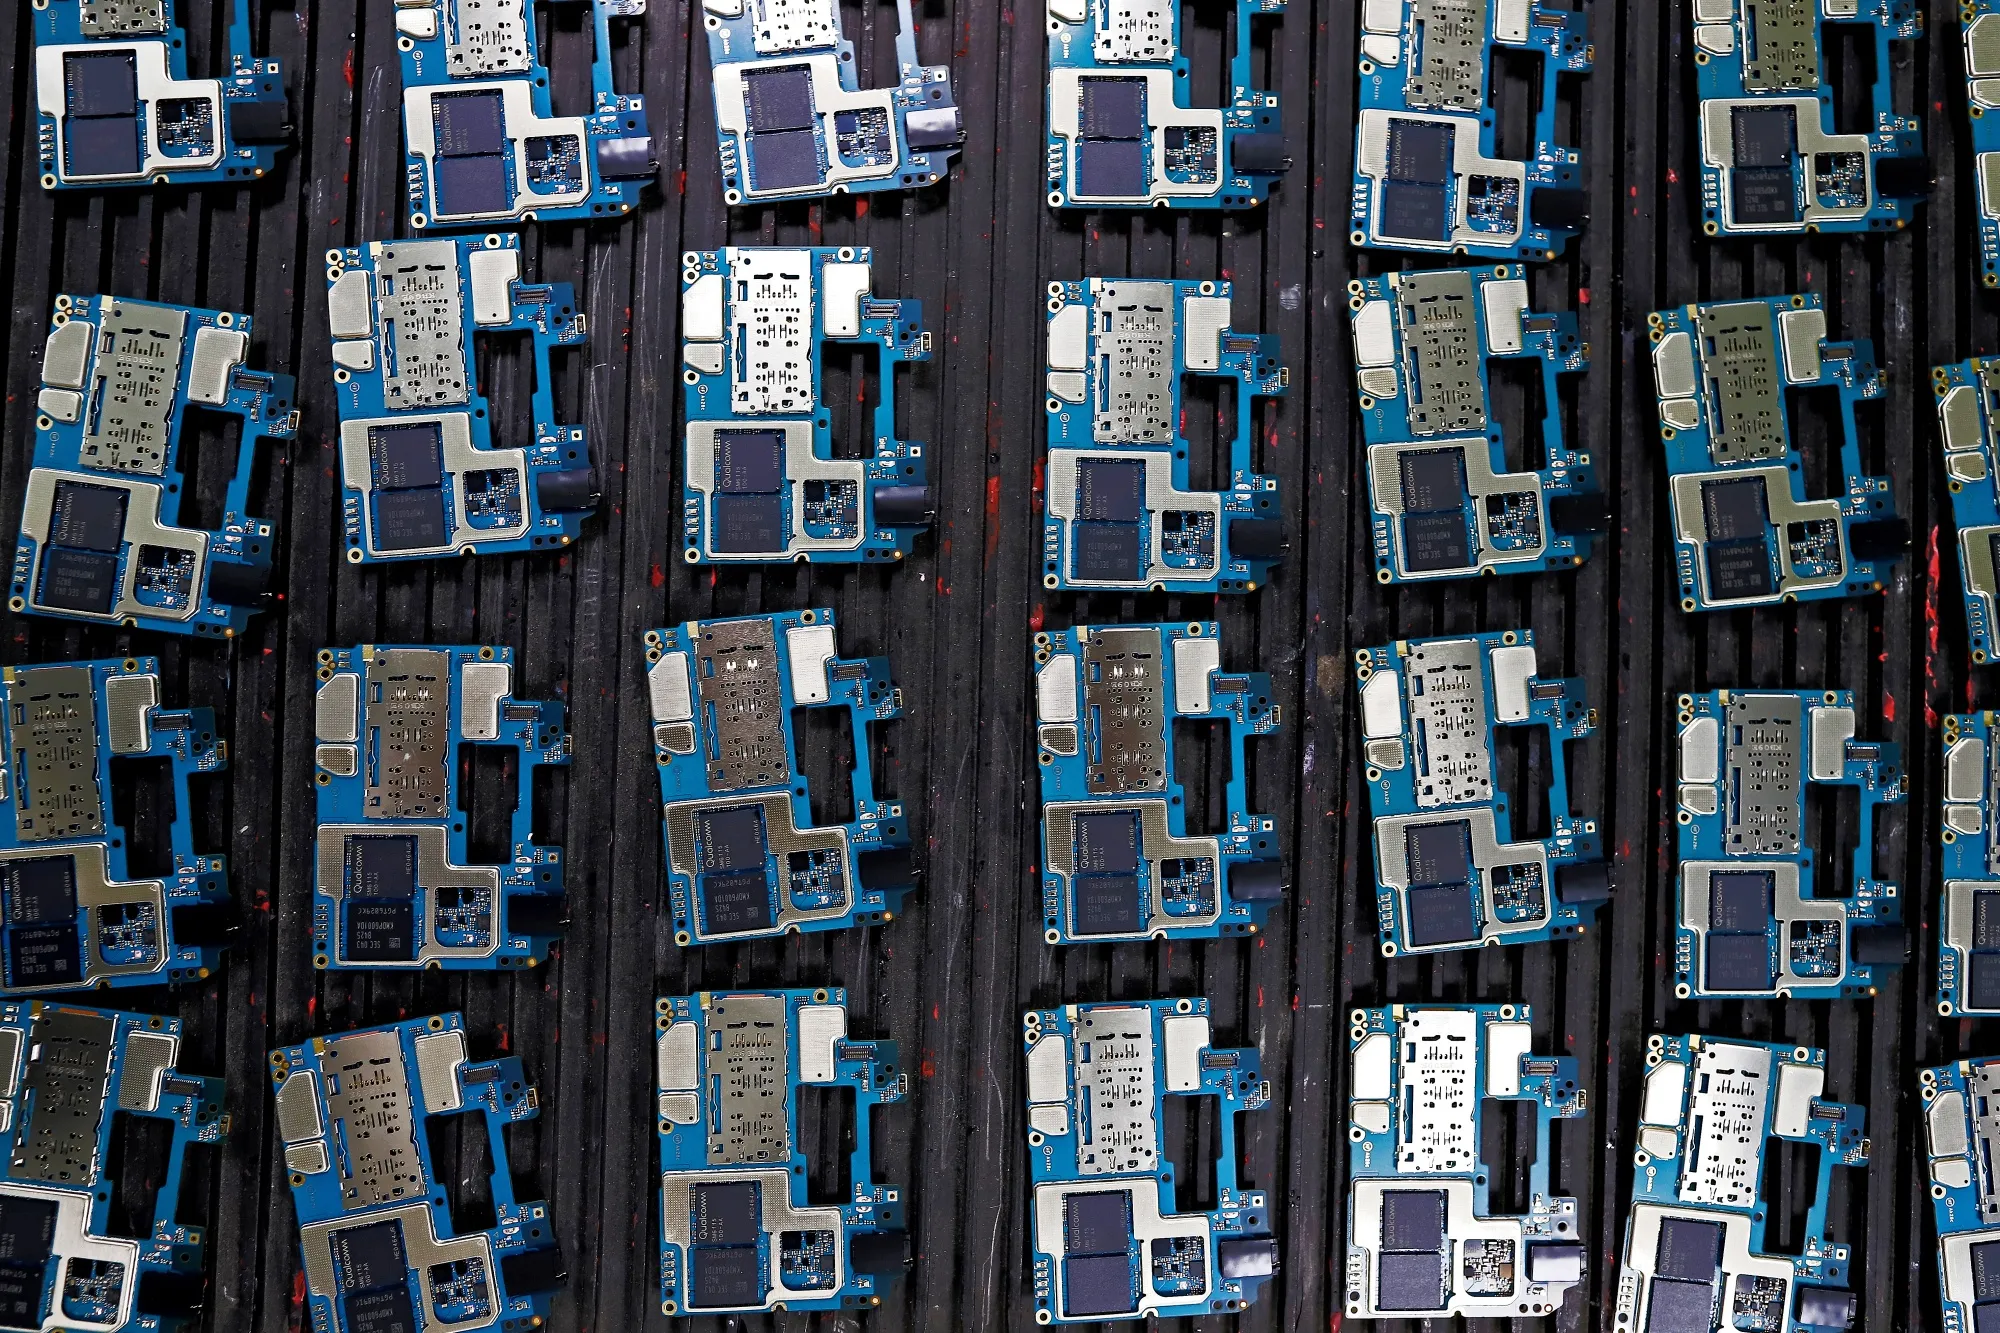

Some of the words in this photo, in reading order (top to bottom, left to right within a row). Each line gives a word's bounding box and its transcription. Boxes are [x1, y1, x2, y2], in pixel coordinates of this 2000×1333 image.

[74, 63, 86, 112] Qualcomm
[752, 79, 764, 127] Qualcomm
[1085, 86, 1095, 133] Qualcomm
[442, 102, 453, 150] Qualcomm
[1737, 116, 1748, 162] Qualcomm
[1392, 129, 1402, 175] Qualcomm
[379, 435, 391, 485] Qualcomm
[722, 439, 732, 488] Qualcomm
[1406, 460, 1418, 508] Qualcomm
[58, 491, 74, 540] Qualcomm
[1083, 468, 1093, 516] Qualcomm
[1708, 490, 1721, 537] Qualcomm
[704, 818, 715, 868] Qualcomm
[1079, 820, 1090, 869] Qualcomm
[1412, 833, 1423, 881] Qualcomm
[353, 844, 363, 894] Qualcomm
[11, 869, 23, 919] Qualcomm
[714, 903, 730, 913] B425
[715, 913, 727, 922] 043
[728, 911, 739, 920] SEC
[1713, 880, 1724, 926] Qualcomm
[356, 931, 371, 939] B425
[356, 940, 367, 948] 043
[370, 940, 380, 948] SEC
[1977, 898, 1987, 945] Qualcomm
[698, 1191, 708, 1240] Qualcomm
[1071, 1200, 1081, 1249] Qualcomm
[1386, 1198, 1396, 1245] Qualcomm
[341, 1238, 355, 1288] Qualcomm
[1661, 1225, 1673, 1272] Qualcomm
[1976, 1250, 1988, 1296] Qualcomm
